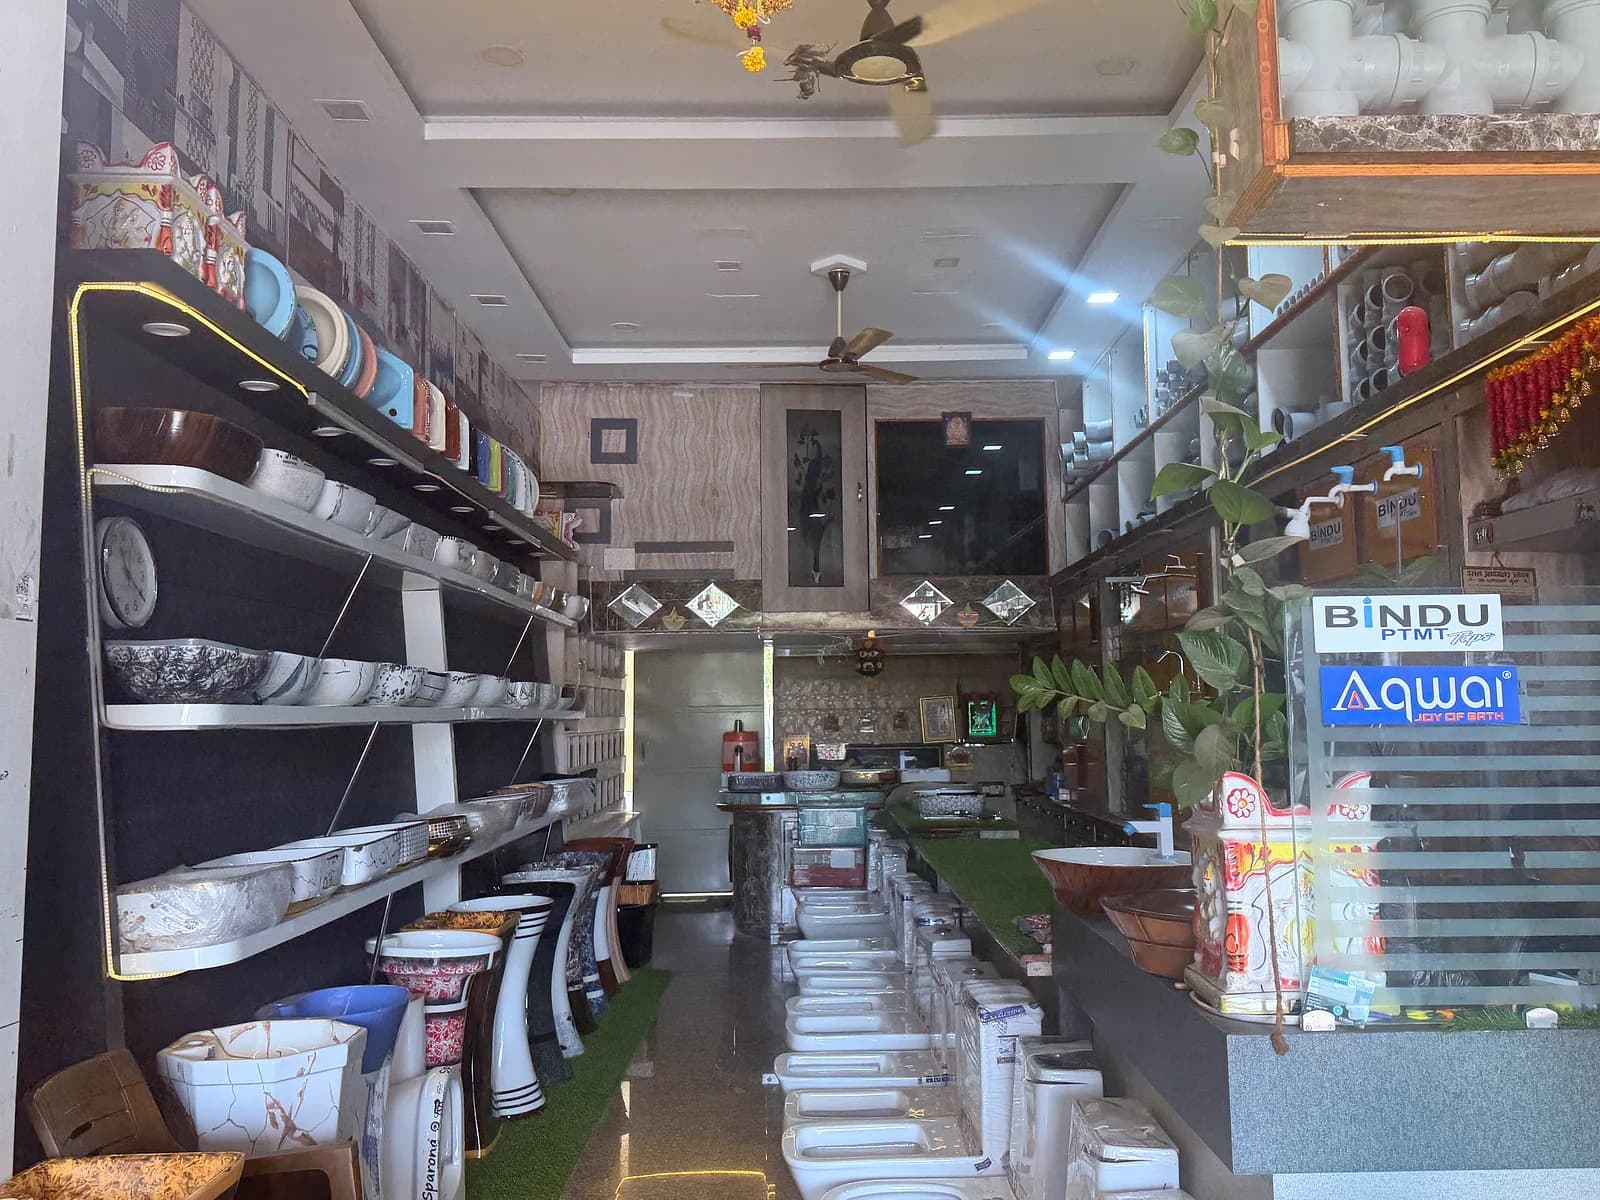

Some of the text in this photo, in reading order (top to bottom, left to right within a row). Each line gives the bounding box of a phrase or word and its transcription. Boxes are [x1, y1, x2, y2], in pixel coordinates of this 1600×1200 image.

[1381, 627, 1496, 647] PTMT Taps
[1413, 711, 1505, 723] JOY OF BATH
